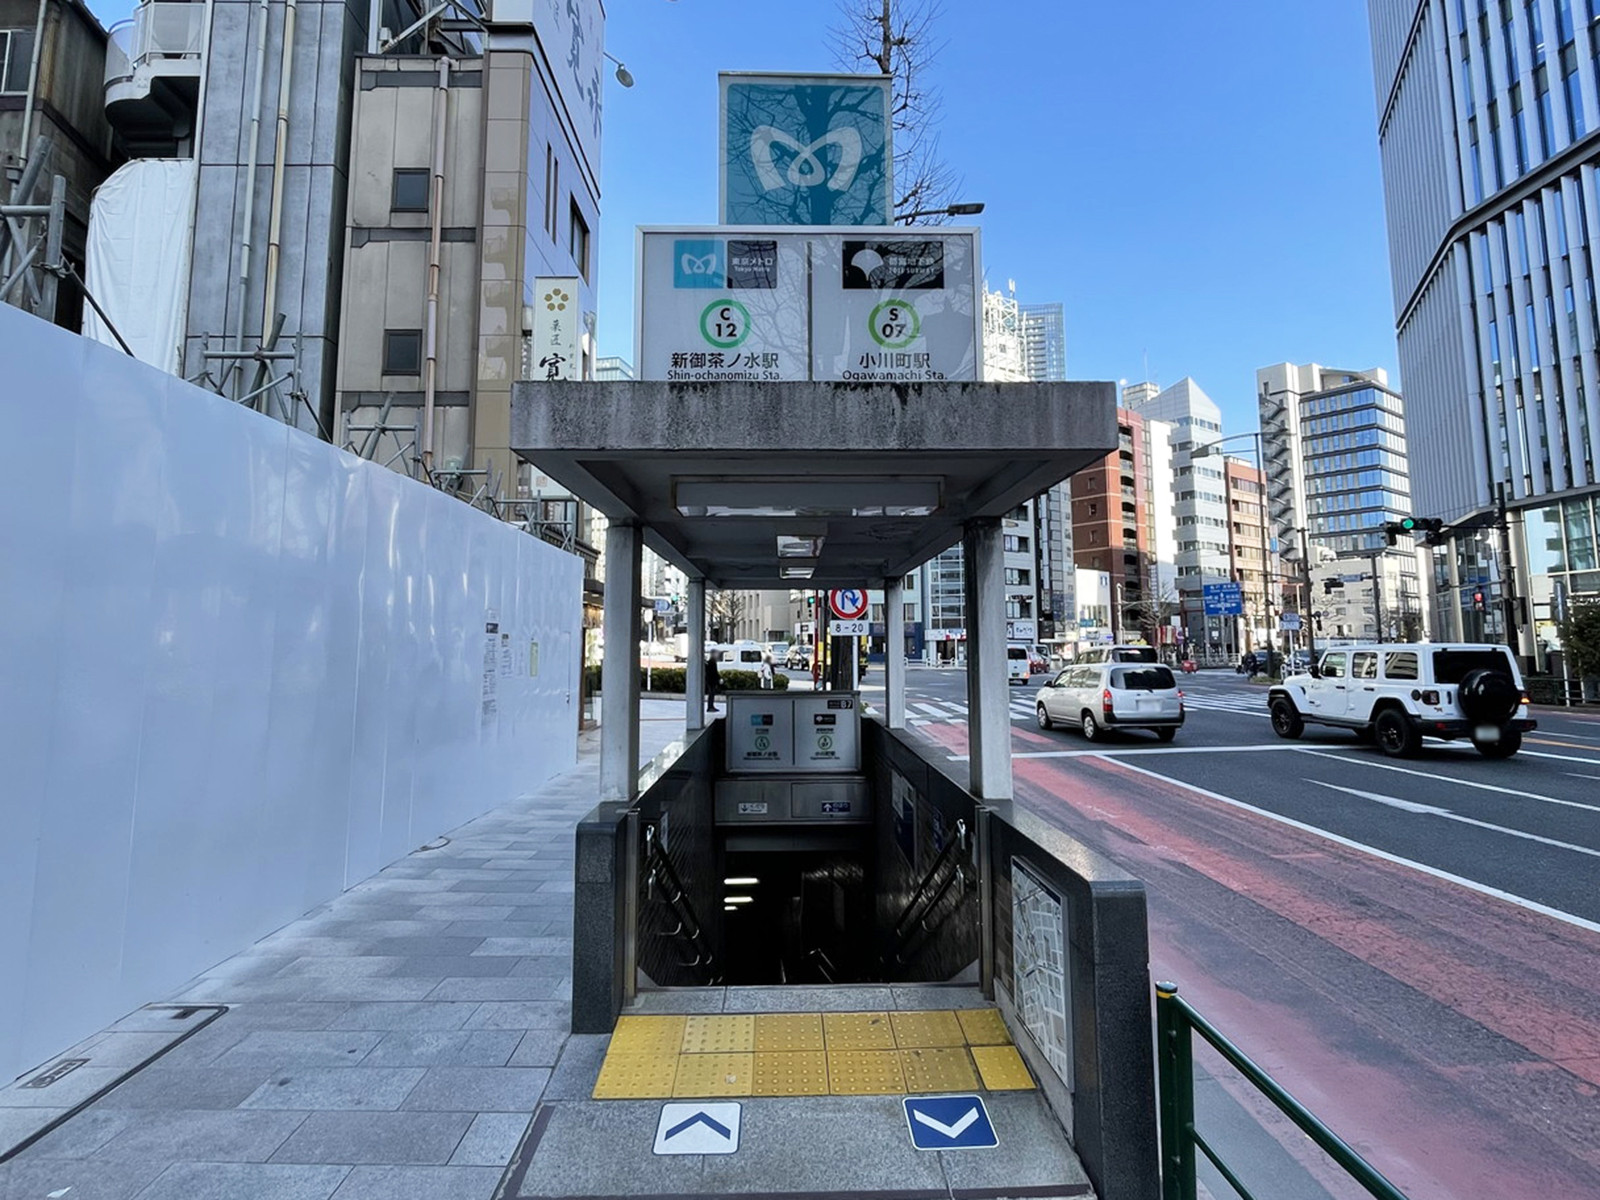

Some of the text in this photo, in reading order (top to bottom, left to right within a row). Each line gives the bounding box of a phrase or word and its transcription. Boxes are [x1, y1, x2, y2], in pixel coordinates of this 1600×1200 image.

[720, 307, 731, 321] C
[889, 307, 899, 321] S
[715, 323, 737, 337] 12
[882, 323, 907, 338] 07
[671, 352, 779, 369] 新御茶ノ水駅
[859, 352, 931, 369] 小川町駅
[667, 370, 784, 380] Shin-ochanomizu Sta.
[842, 370, 948, 381] Ogawamachi Sta.
